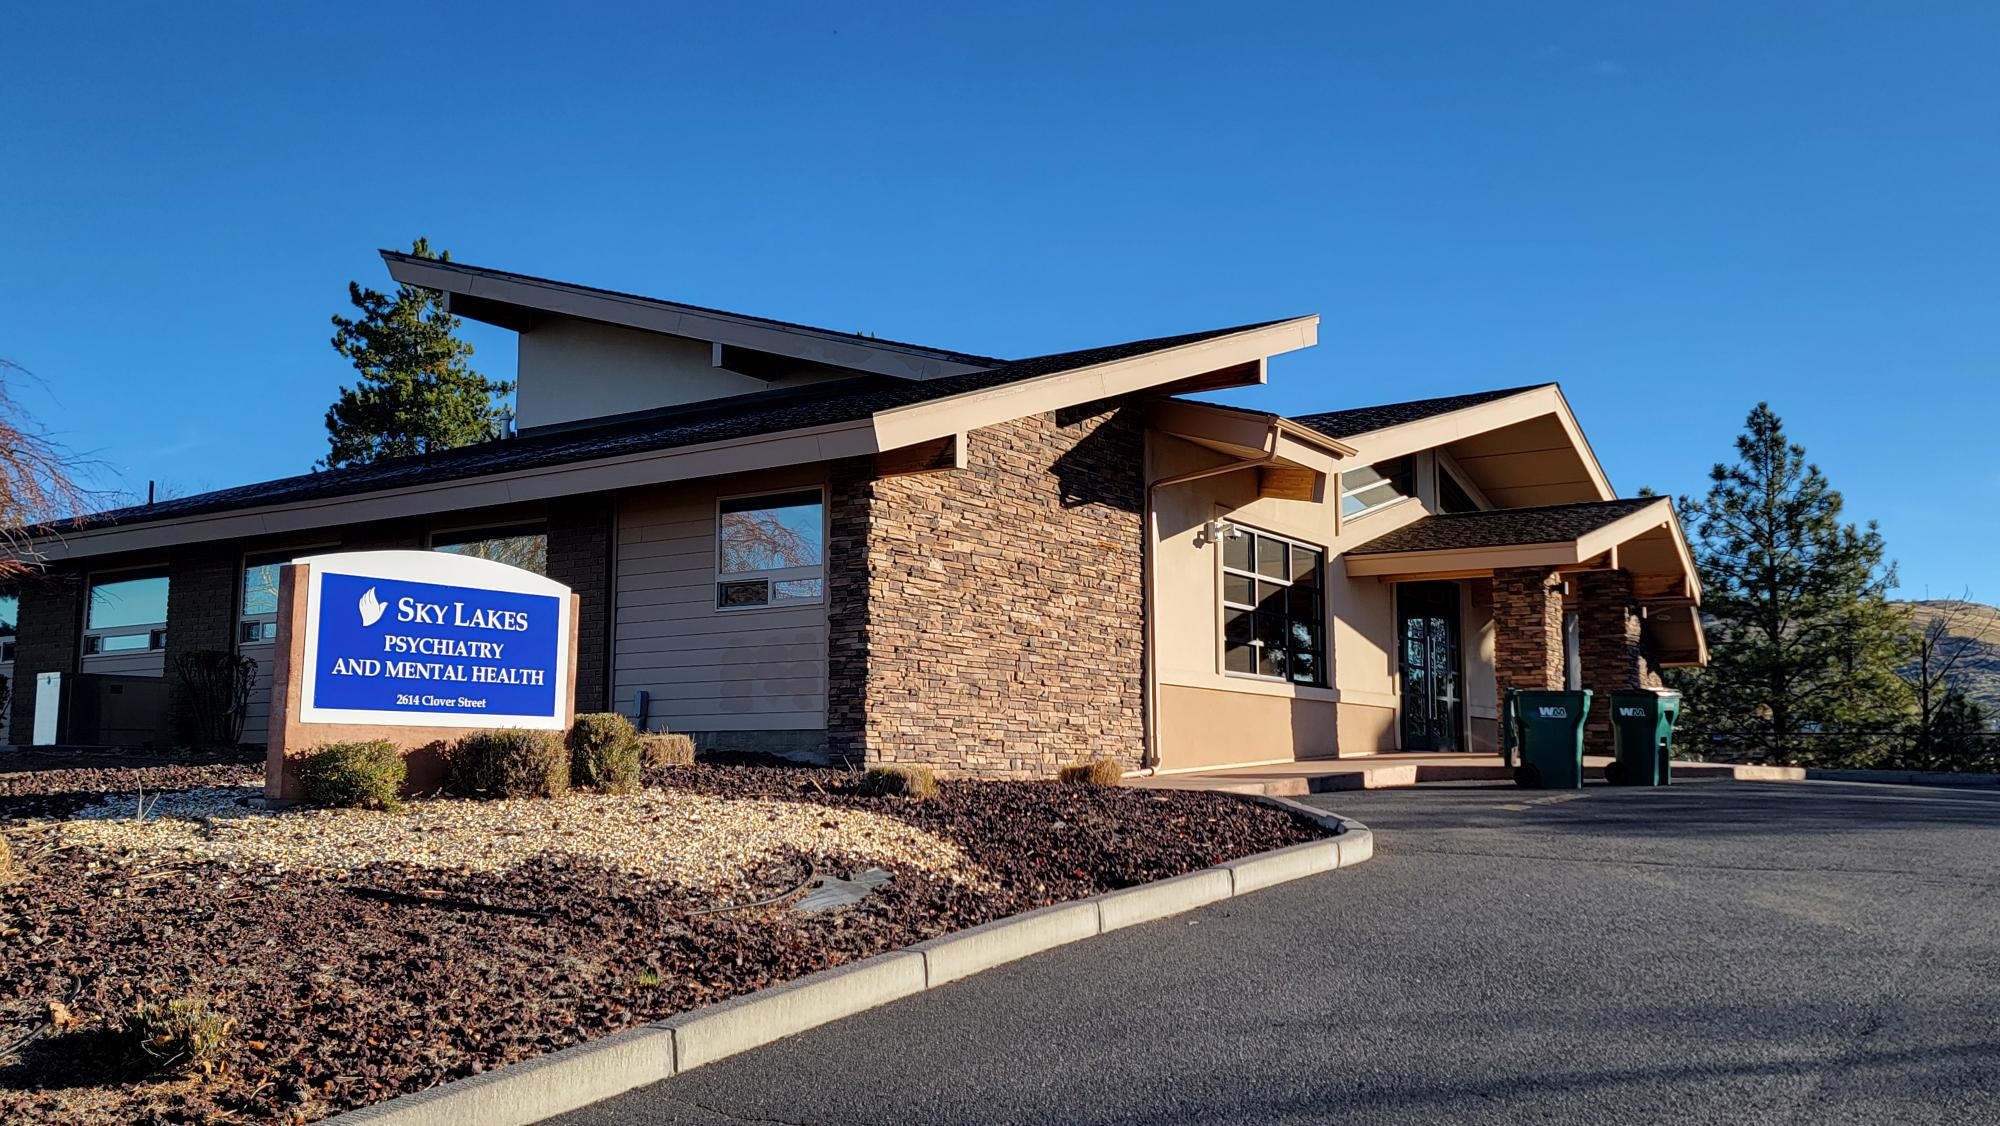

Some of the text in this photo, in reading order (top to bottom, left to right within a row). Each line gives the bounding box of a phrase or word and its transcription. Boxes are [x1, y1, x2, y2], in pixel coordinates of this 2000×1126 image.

[397, 596, 529, 632] SKY LAKES
[383, 634, 505, 660] PSYCHIATRY
[331, 657, 545, 686] AND MENTAL HEALTH
[396, 693, 487, 708] 2614 Clover Street
[1538, 706, 1567, 717] WM
[1619, 707, 1646, 717] WM
